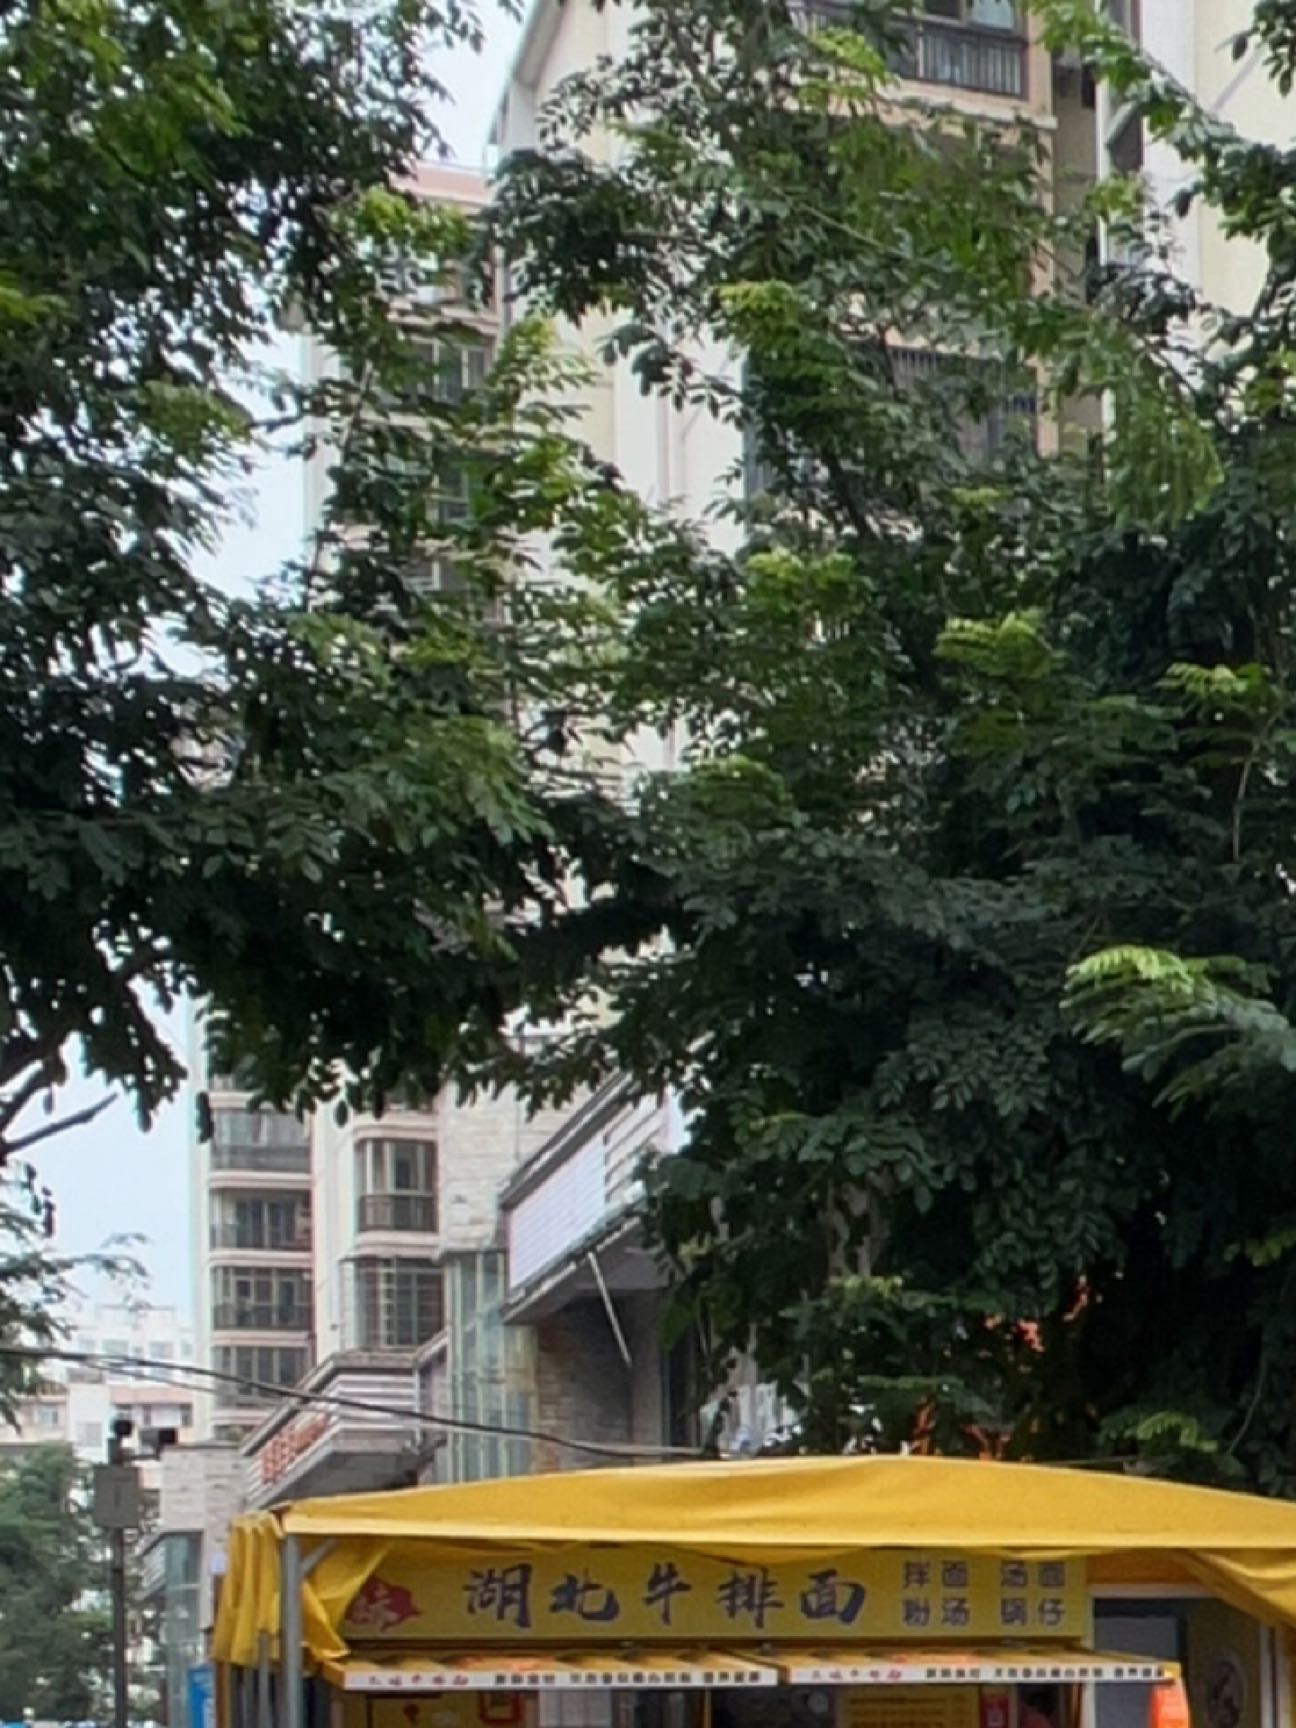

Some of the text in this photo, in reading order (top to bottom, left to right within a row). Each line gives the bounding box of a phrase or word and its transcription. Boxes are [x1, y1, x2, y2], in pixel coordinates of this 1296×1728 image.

[462, 1562, 866, 1629] 湖北牛排面
